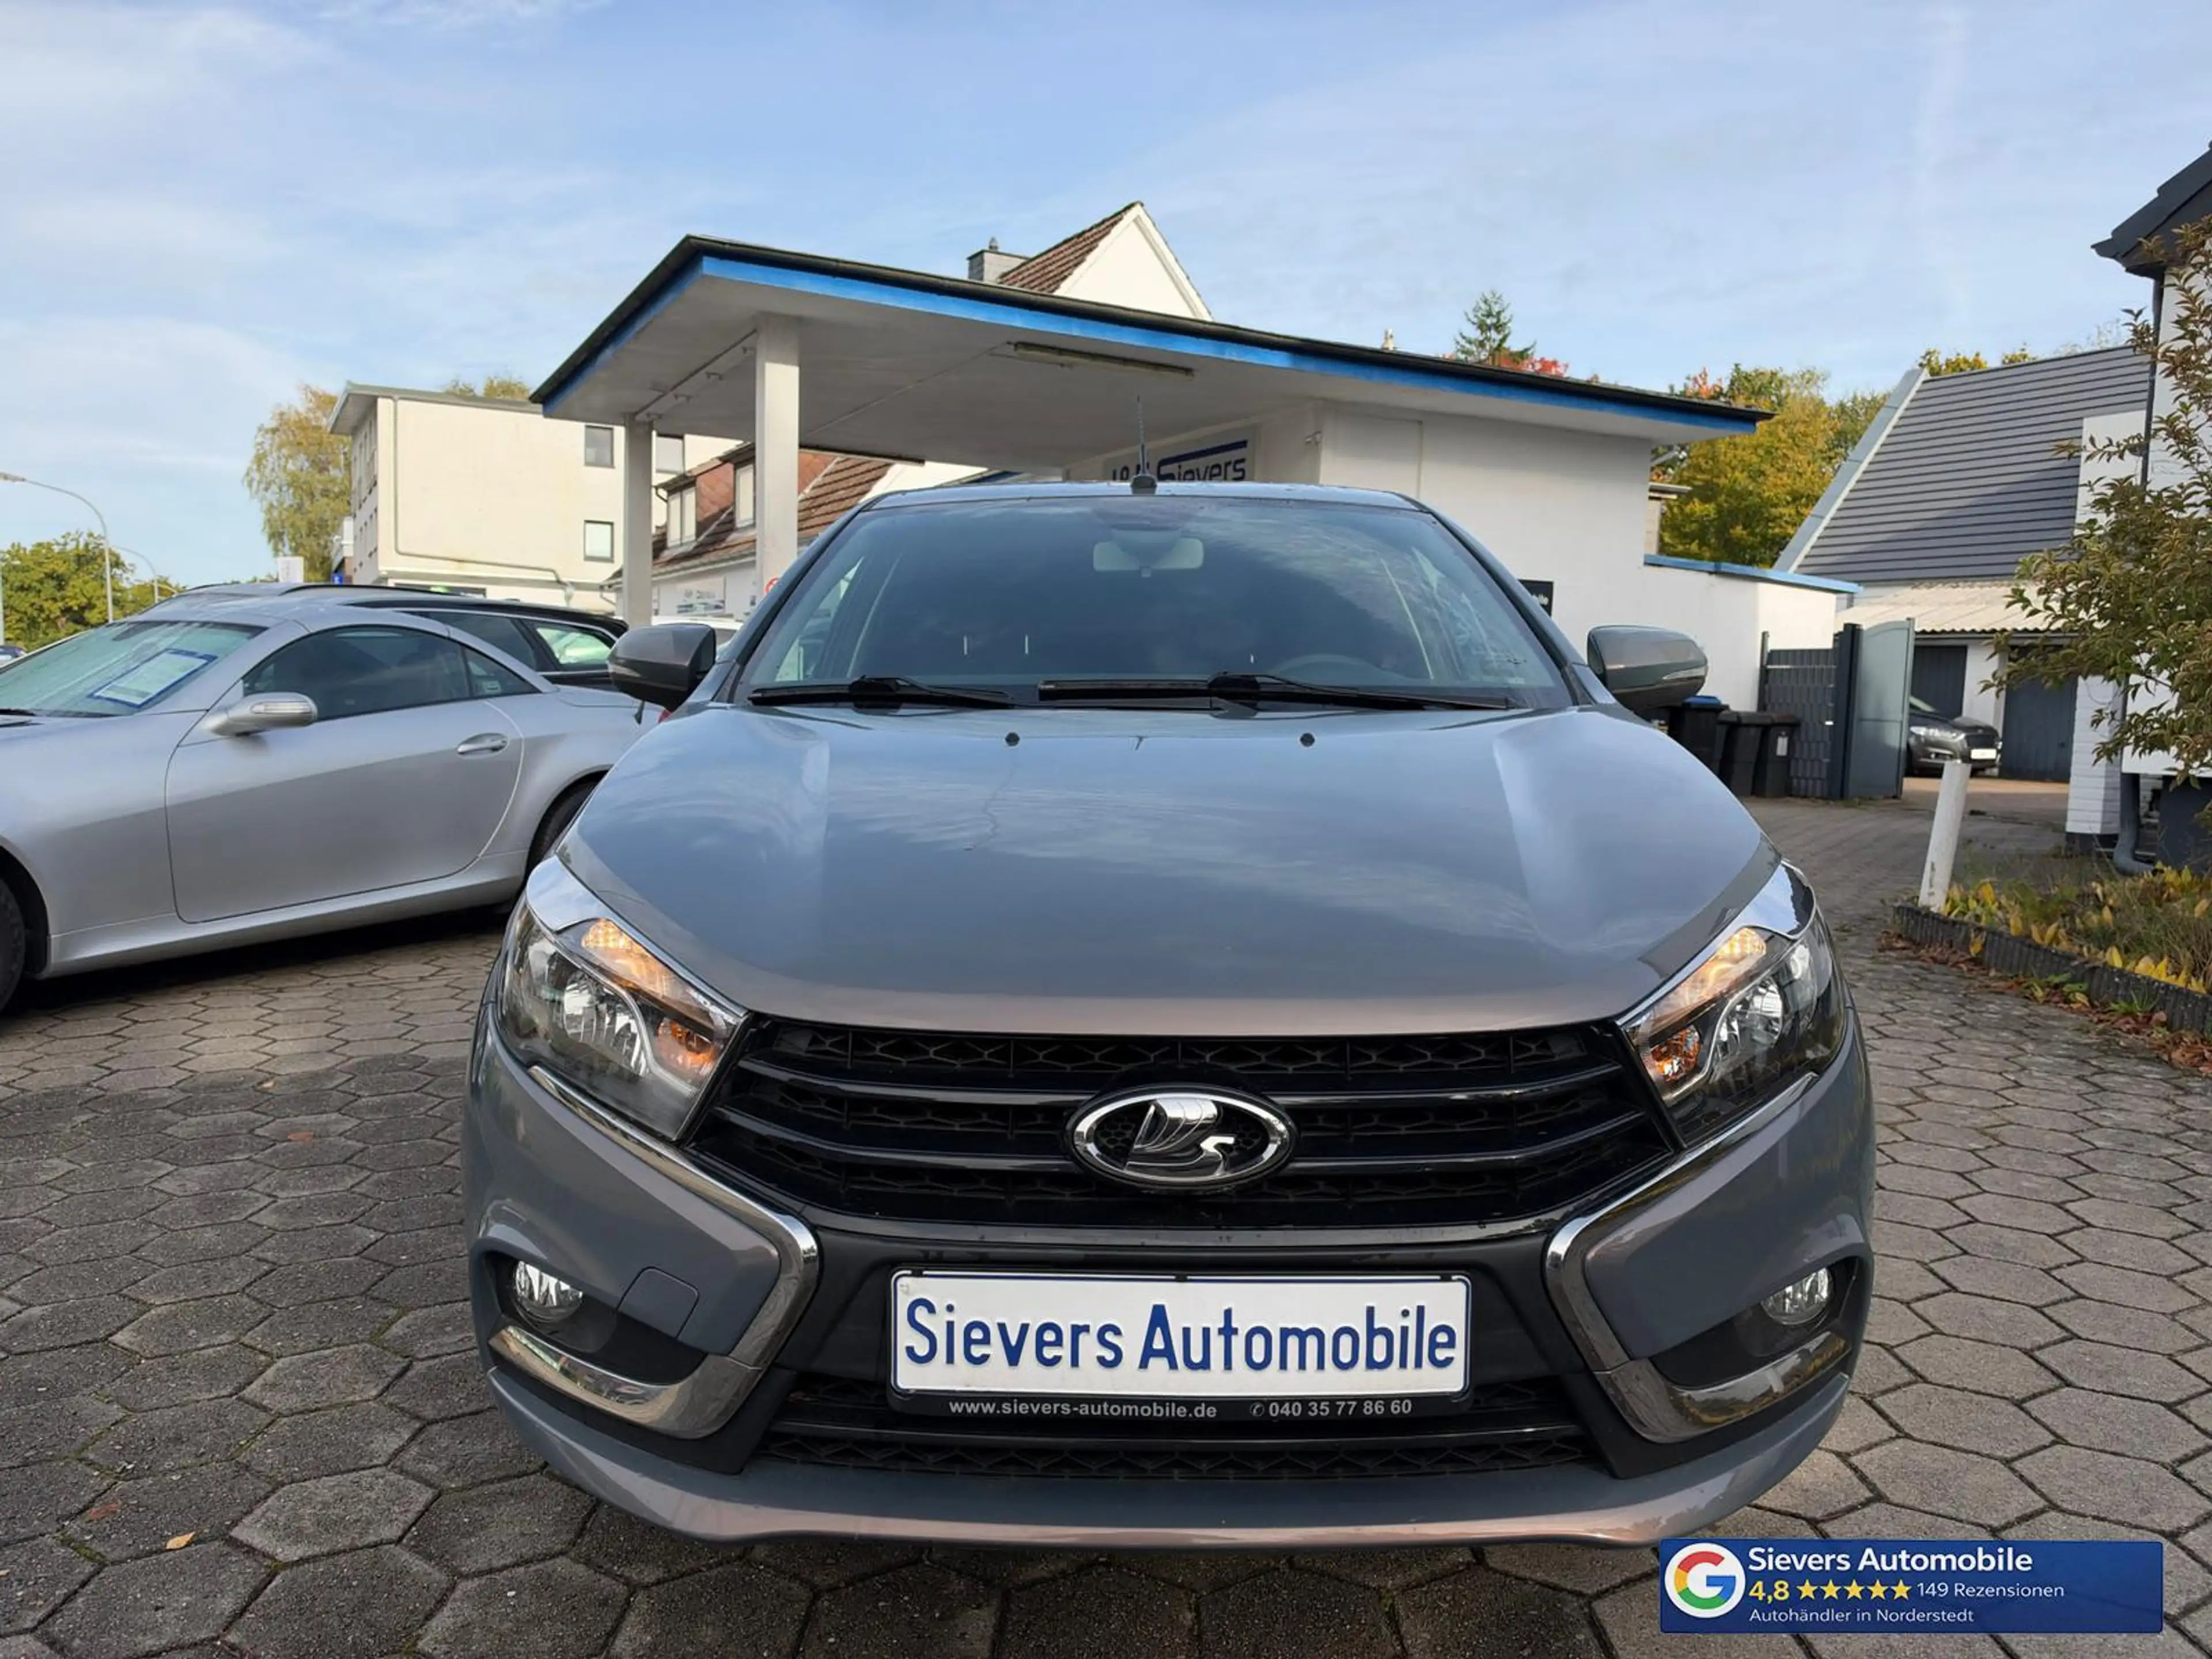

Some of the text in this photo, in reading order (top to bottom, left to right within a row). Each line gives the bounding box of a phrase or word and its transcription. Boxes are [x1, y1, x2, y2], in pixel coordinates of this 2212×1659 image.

[906, 1298, 1457, 1372] Sievers Automobile
[949, 1398, 1412, 1418] www.sievers-automobile.de 040 35 77 86 60
